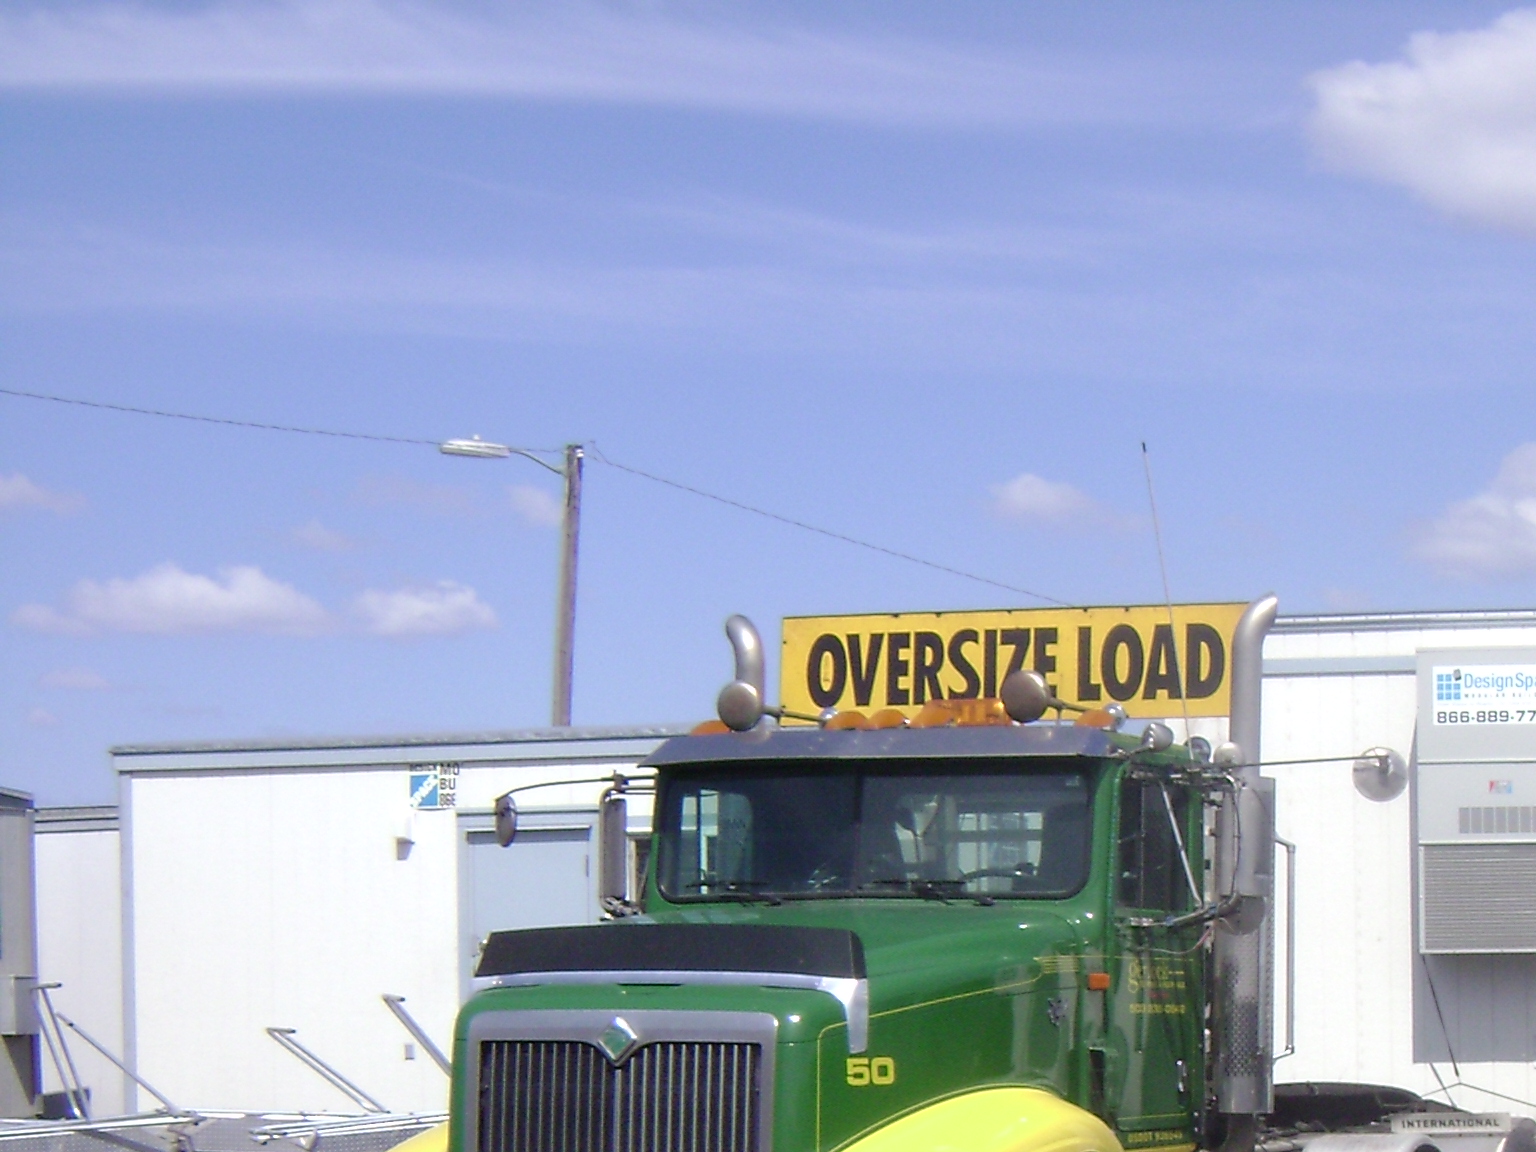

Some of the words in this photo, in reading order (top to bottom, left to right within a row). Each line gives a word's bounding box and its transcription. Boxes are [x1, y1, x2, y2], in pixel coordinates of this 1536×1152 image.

[807, 628, 1058, 708] OVERSIZE
[1076, 623, 1226, 703] LOAD
[846, 1057, 895, 1086] 50
[1402, 1119, 1500, 1129] INTERNATIONAL
